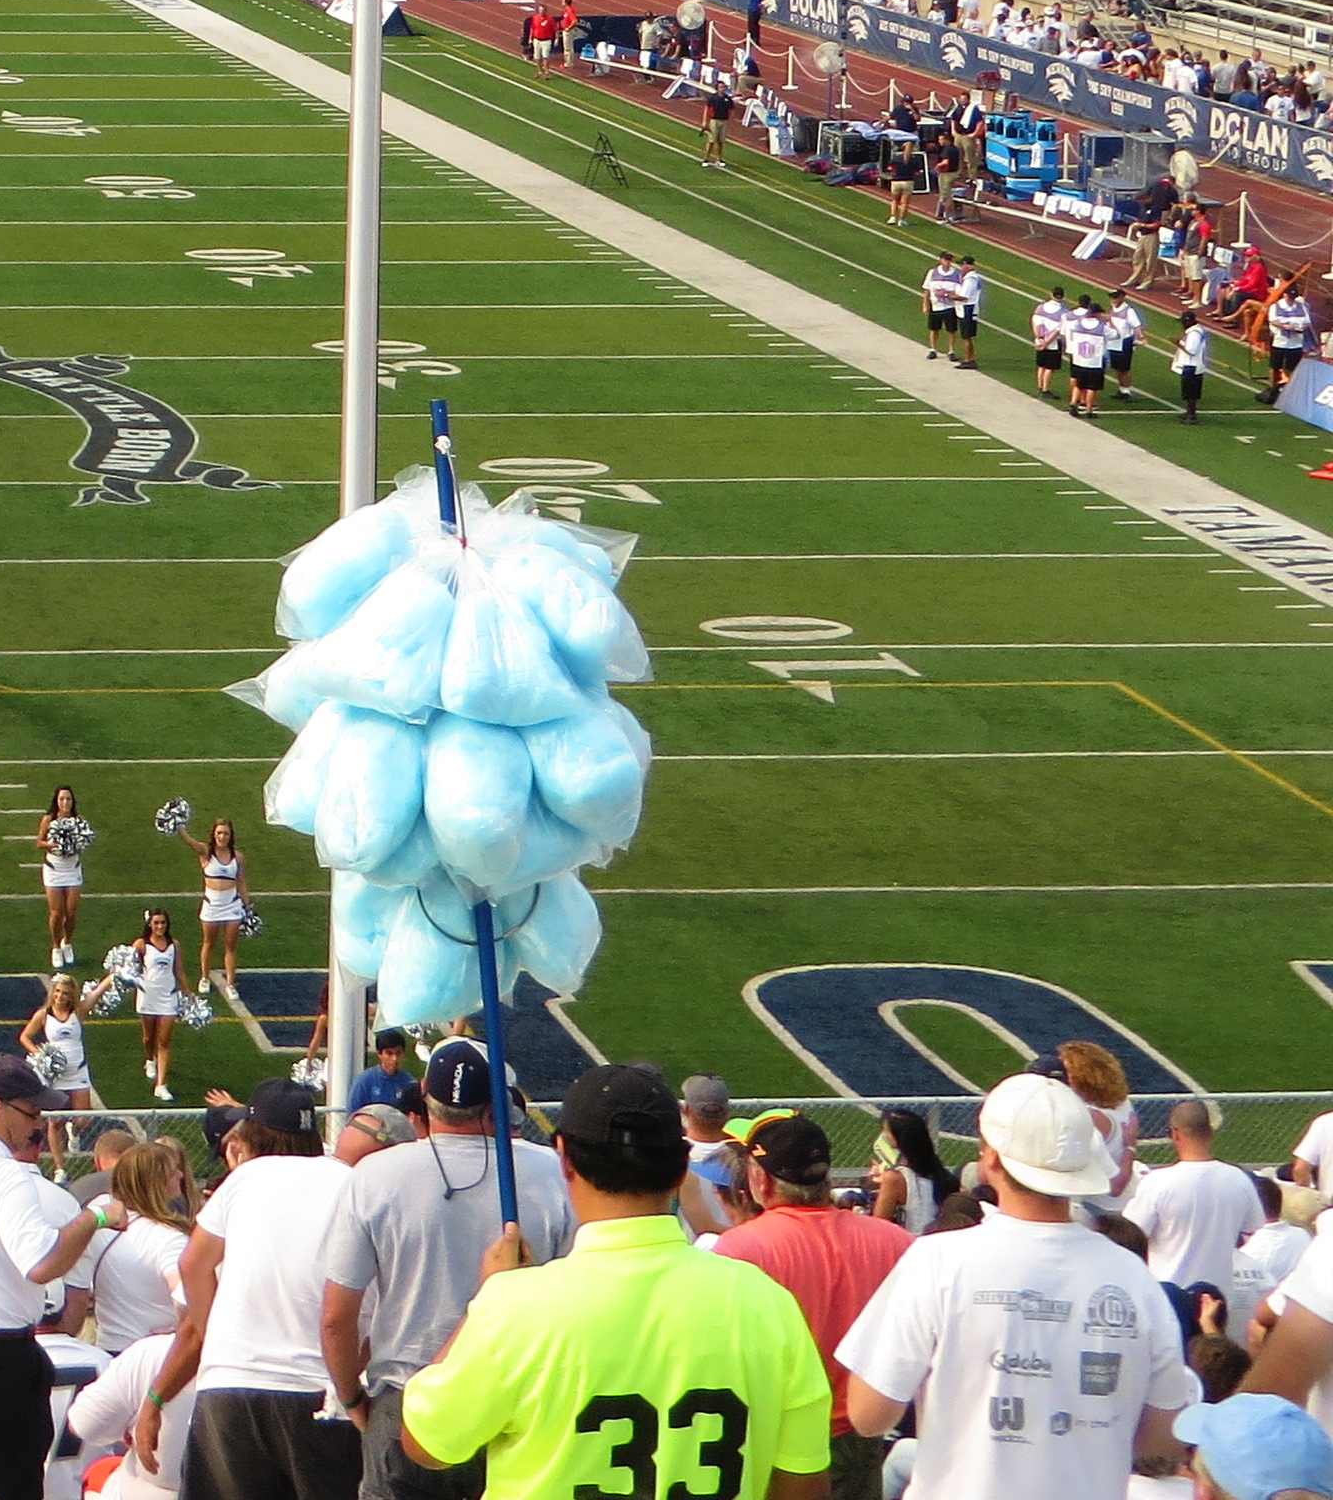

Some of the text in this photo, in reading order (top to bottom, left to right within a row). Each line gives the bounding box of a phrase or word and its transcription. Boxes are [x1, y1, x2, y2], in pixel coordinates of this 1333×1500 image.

[790, 12, 838, 36] AUTO GROUP
[1209, 107, 1289, 160] DOLAN
[1246, 152, 1288, 172] GROUP
[5, 366, 172, 473] BATTLE BORN
[698, 615, 922, 679] 10
[573, 1388, 750, 1500] 33
